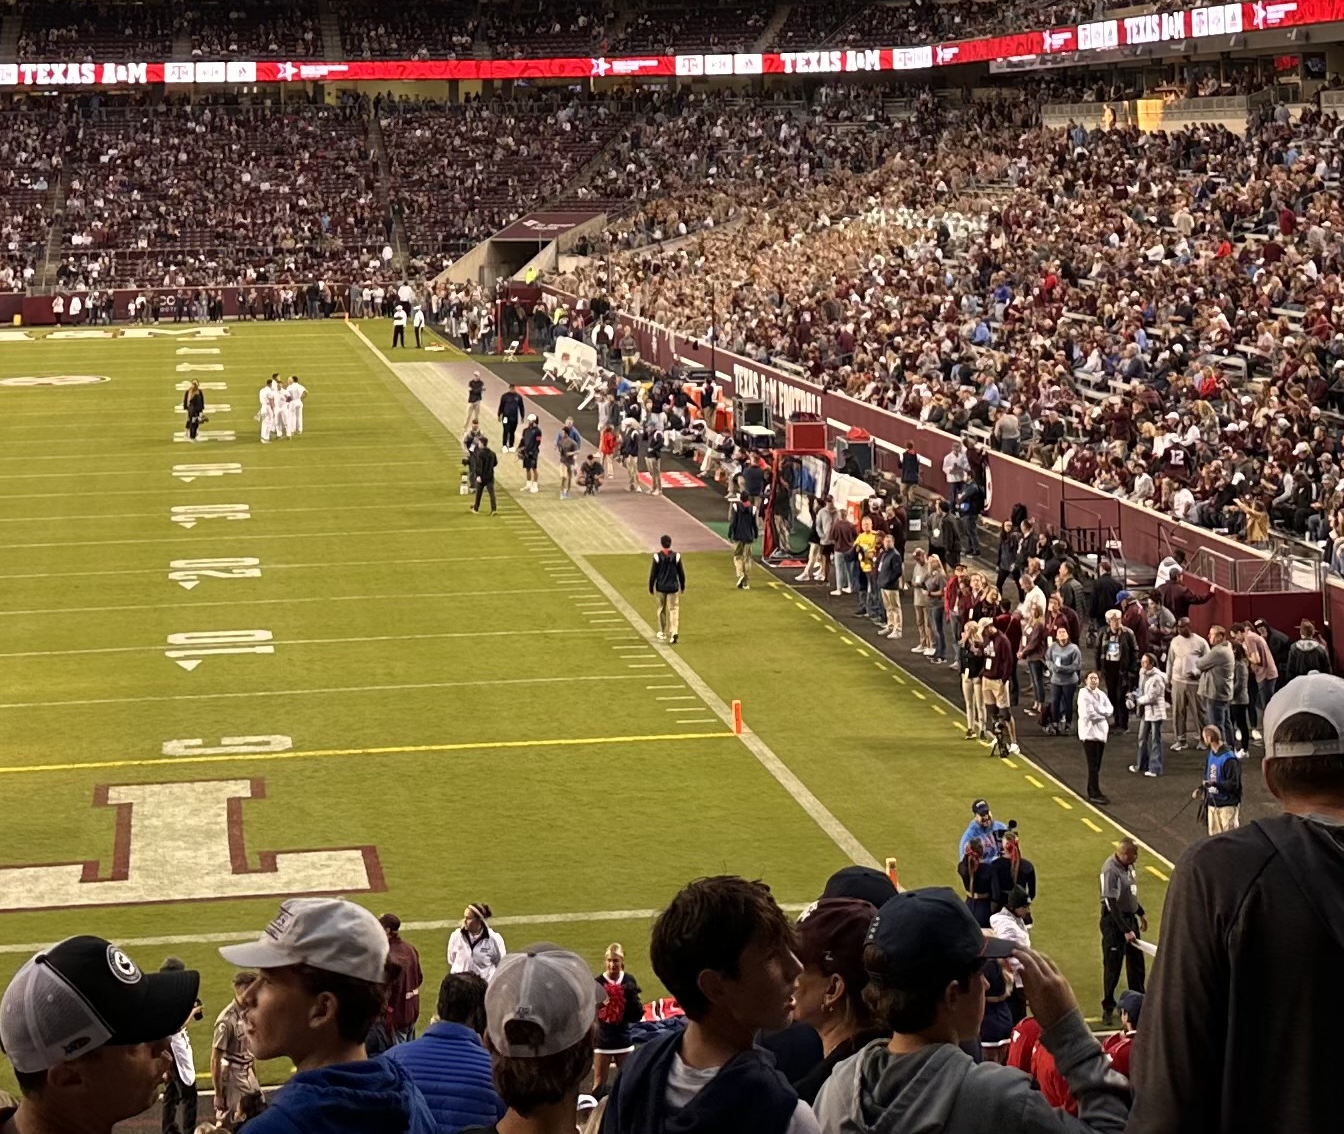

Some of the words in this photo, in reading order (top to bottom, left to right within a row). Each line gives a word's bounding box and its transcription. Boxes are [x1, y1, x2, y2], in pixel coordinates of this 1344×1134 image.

[1124, 13, 1160, 45] TEXAS
[1161, 10, 1185, 41] A&M
[19, 63, 96, 85] TEXAS
[102, 62, 148, 84] A&M
[780, 50, 842, 74] TEXAS
[846, 49, 881, 72] A&M
[733, 363, 759, 400] TEXAS
[778, 381, 822, 420] FOOTBALL
[1170, 449, 1184, 465] 12
[168, 557, 262, 580] 20
[165, 629, 275, 659] 10
